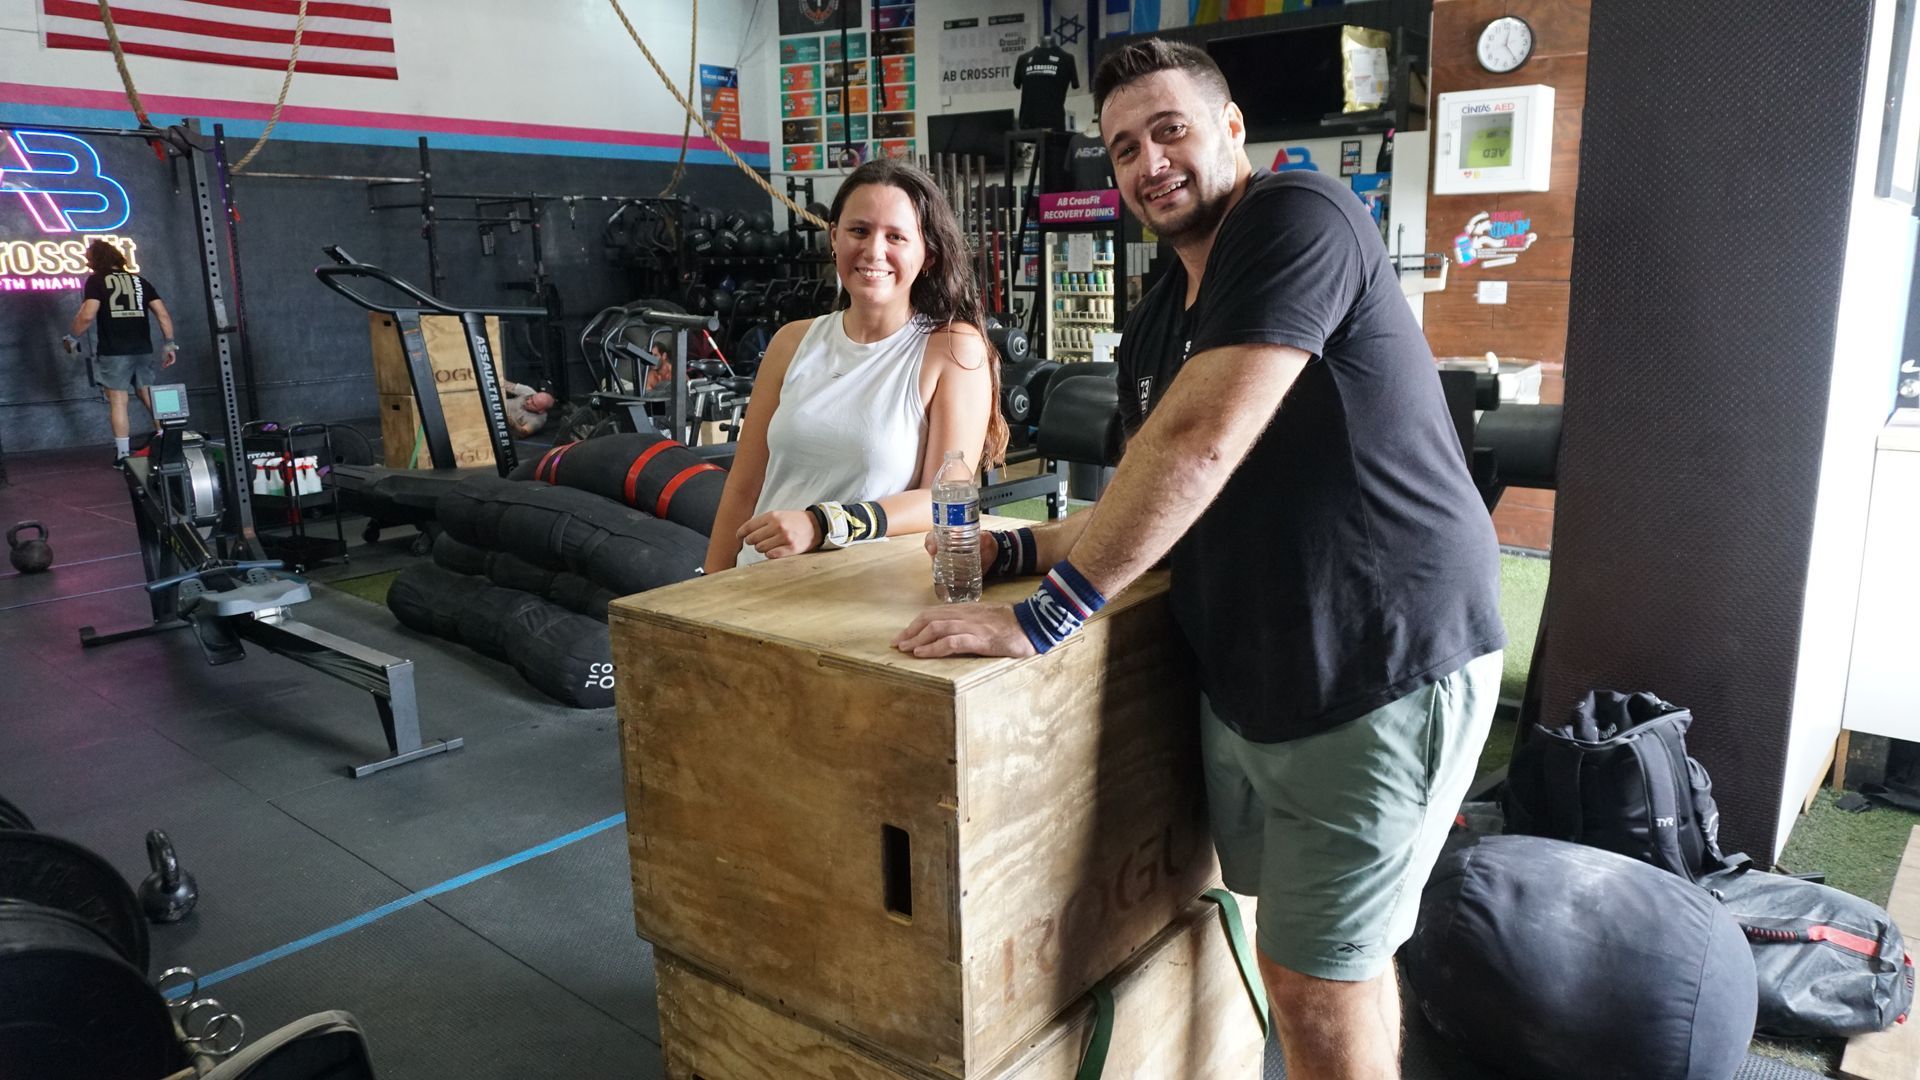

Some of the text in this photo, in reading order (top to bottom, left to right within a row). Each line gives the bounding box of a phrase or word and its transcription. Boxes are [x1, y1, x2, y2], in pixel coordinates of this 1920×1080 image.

[943, 70, 957, 82] AB
[960, 66, 1011, 80] CROSSFIT
[1461, 103, 1515, 114] CINTAS AED
[1057, 195, 1100, 206] AB CrossFit
[1044, 208, 1115, 219] RECOVERY DRINKS
[32, 277, 82, 290] MIAMI
[104, 274, 136, 310] 24
[1656, 817, 1674, 827] TYR
